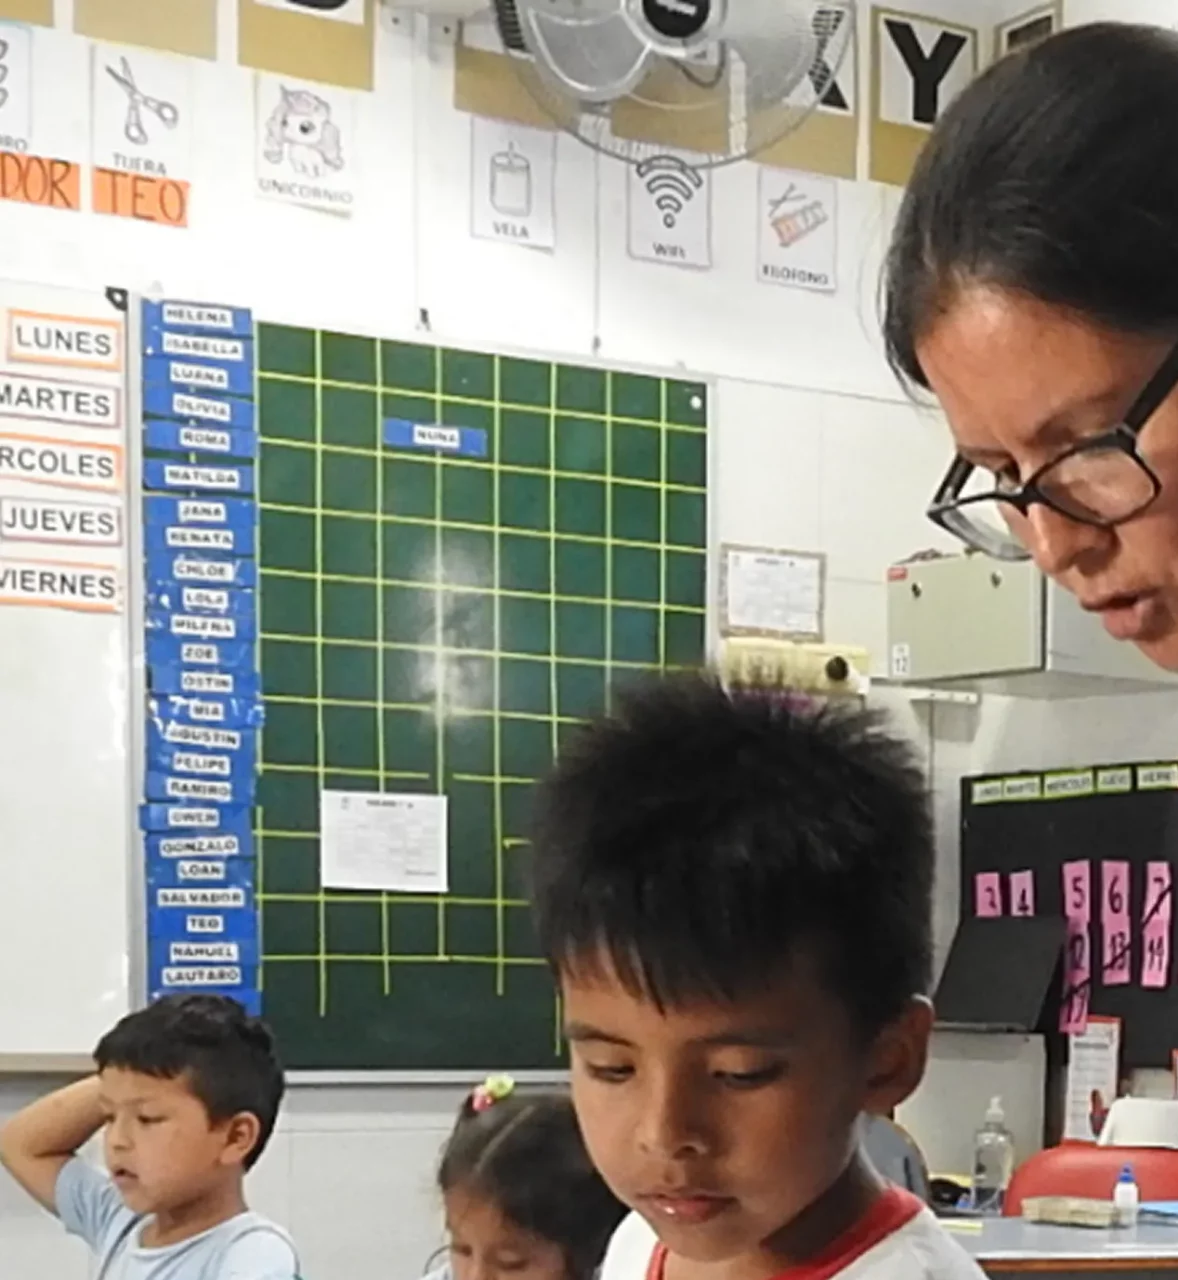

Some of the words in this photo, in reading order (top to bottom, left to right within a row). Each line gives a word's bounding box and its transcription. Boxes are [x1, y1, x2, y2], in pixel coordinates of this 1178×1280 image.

[884, 18, 967, 123] Y
[113, 152, 167, 176] TIJERA
[0, 152, 72, 208] DOR
[95, 166, 186, 222] TEO
[258, 179, 353, 204] UNICORNIO
[493, 221, 529, 239] VELA
[167, 308, 229, 323] HELENA
[15, 324, 112, 357] LUNES
[184, 431, 226, 445] ROMA
[4, 507, 115, 536] JUEVES
[176, 756, 225, 771] FELIPE
[180, 863, 220, 877] LOAN
[160, 891, 241, 904] SALVADOR
[1071, 876, 1086, 909] 5
[1108, 875, 1124, 914] 6
[190, 917, 220, 930] TEO
[166, 968, 238, 983] LAUTARO
